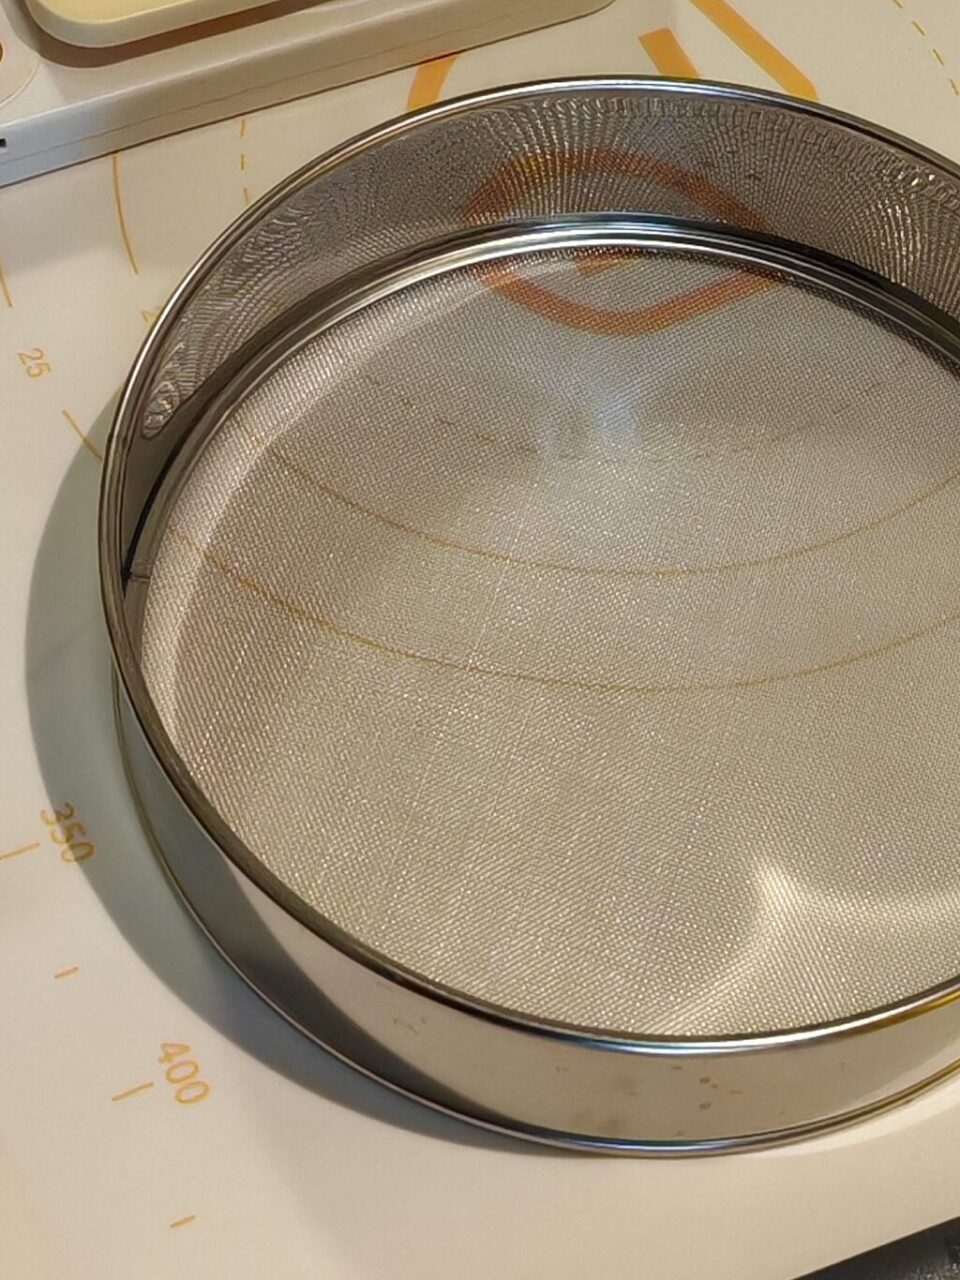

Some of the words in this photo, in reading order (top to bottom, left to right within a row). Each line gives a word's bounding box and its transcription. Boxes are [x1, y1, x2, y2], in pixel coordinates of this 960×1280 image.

[17, 347, 52, 378] 25
[40, 802, 95, 863] 350
[158, 1042, 210, 1105] 400
